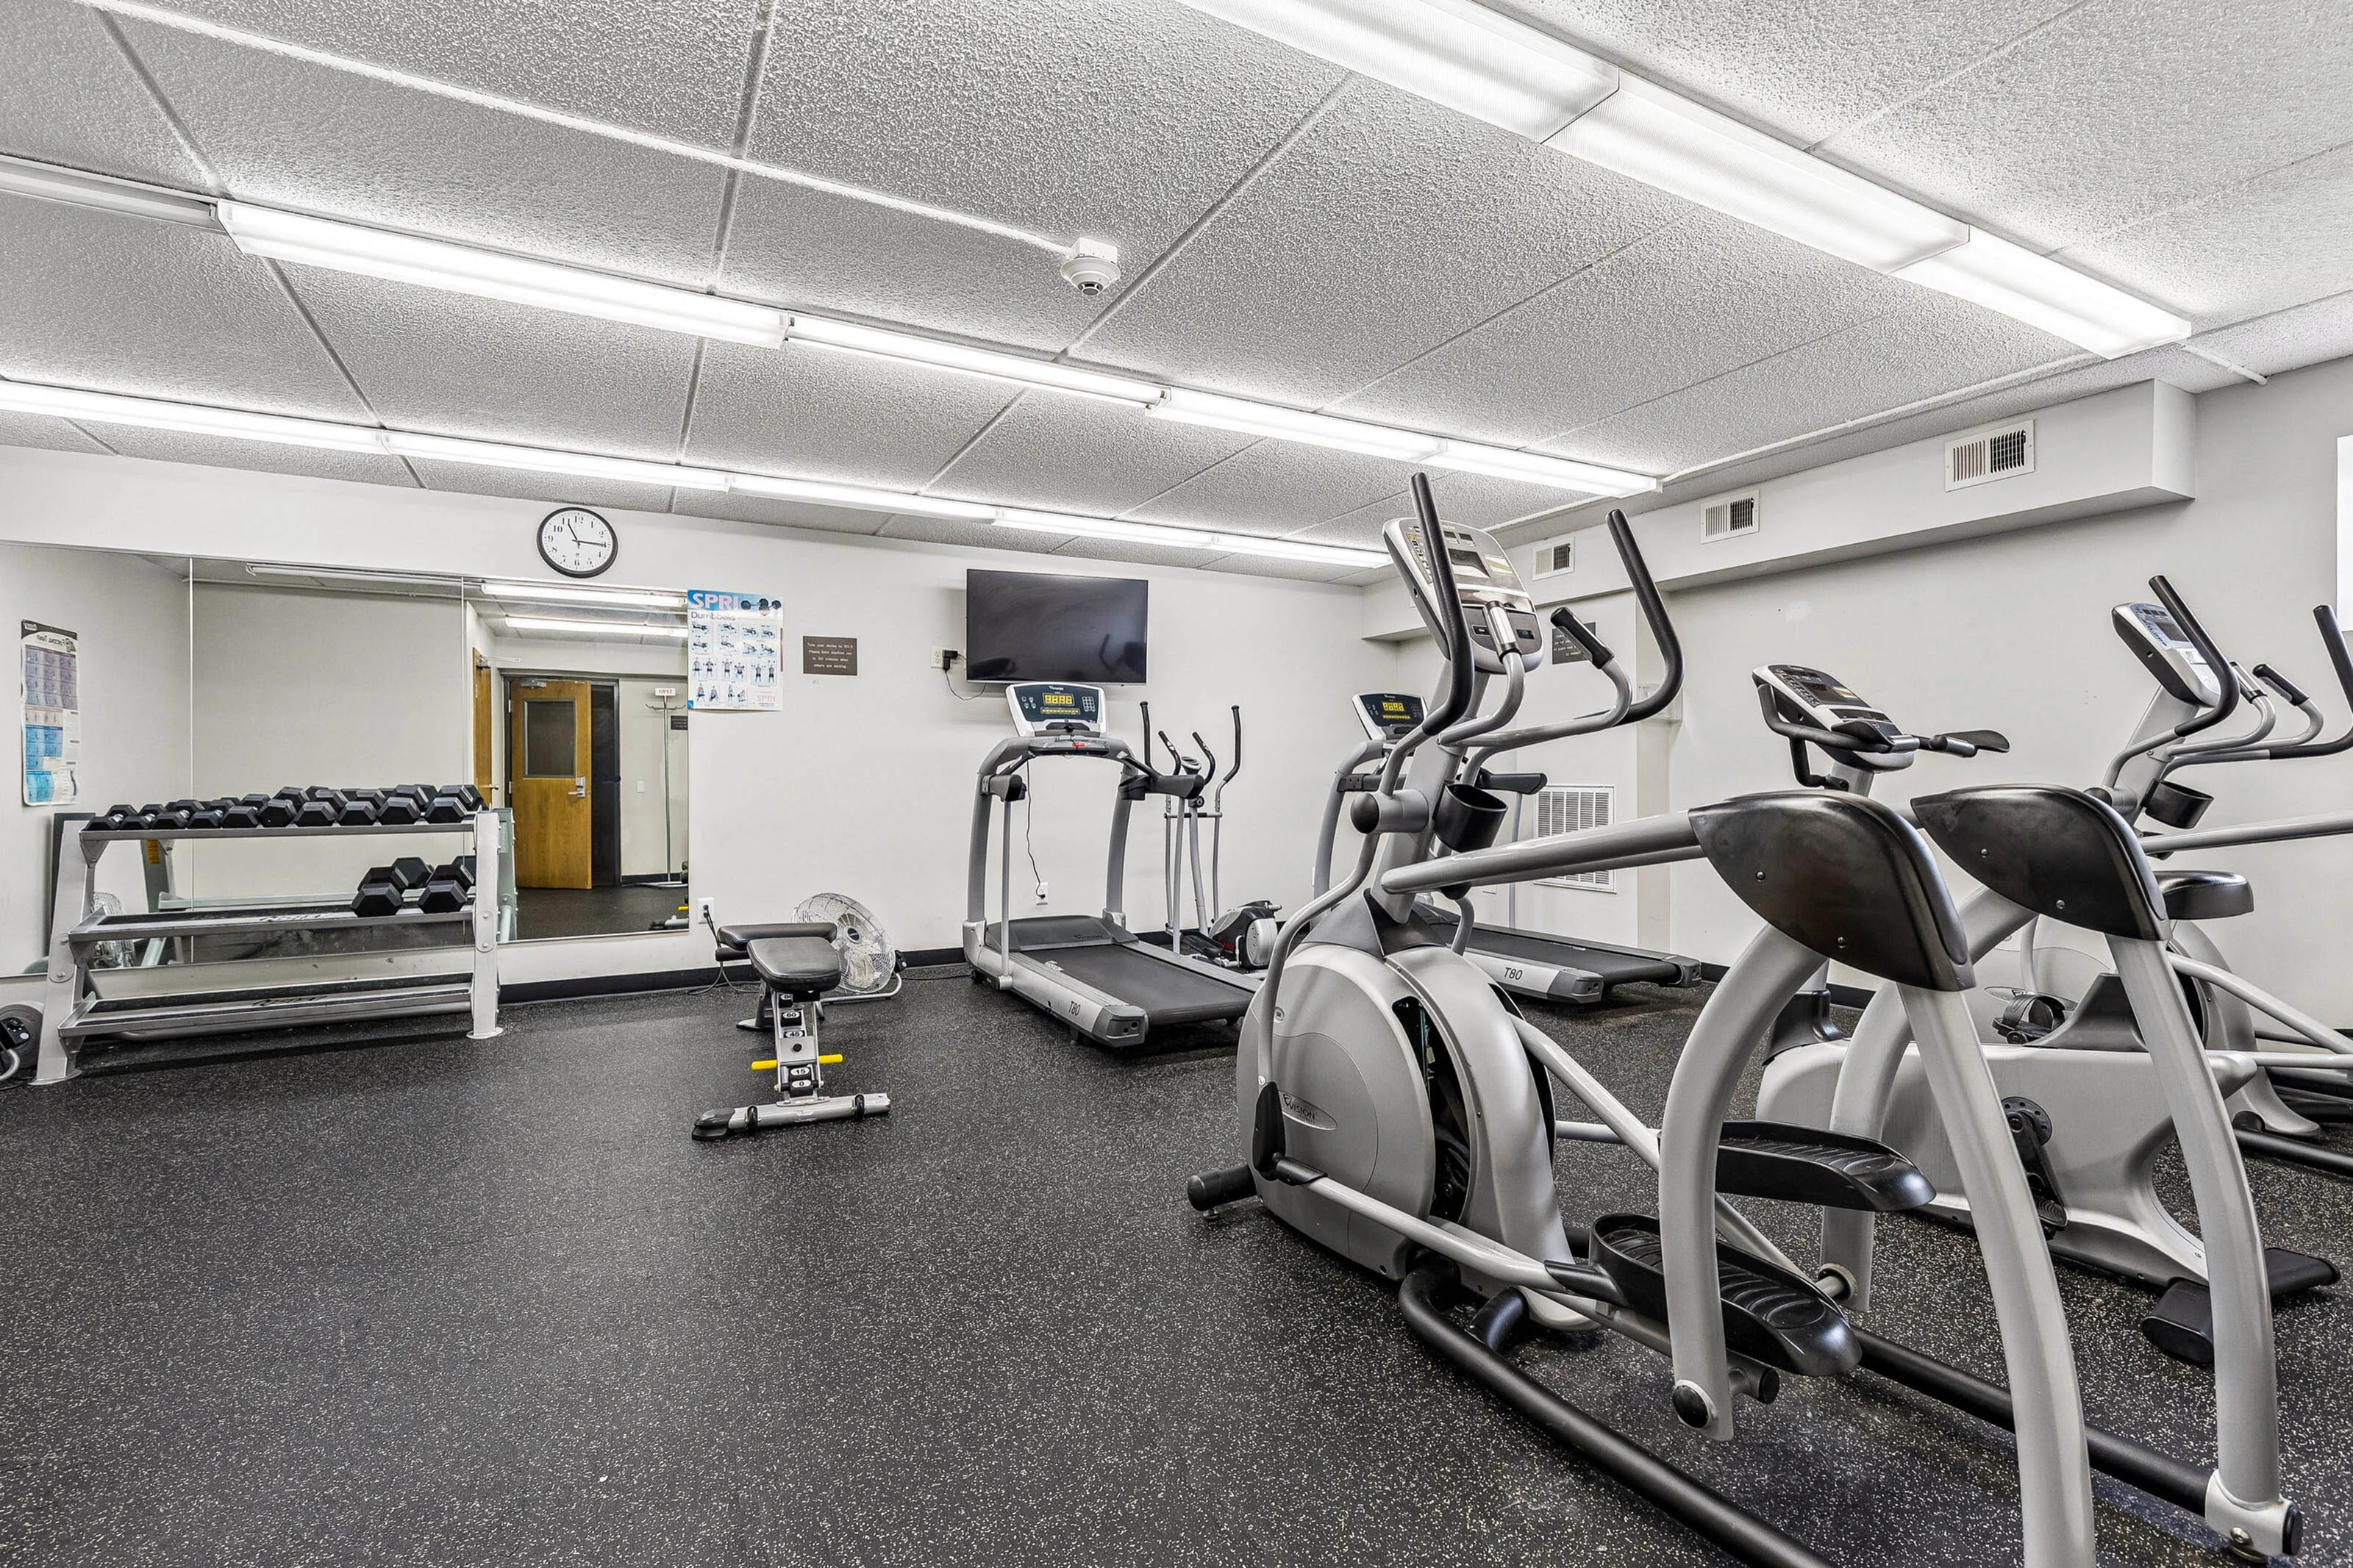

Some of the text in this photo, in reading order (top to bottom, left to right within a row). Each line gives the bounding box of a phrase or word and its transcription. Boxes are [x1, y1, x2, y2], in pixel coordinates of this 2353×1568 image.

[574, 515, 584, 524] 12
[553, 525, 563, 533] 10
[548, 534, 554, 543] 9
[562, 554, 567, 562] 7
[586, 557, 593, 565] 5
[693, 593, 739, 611] SPRI
[691, 611, 736, 620] Dumbbells
[1504, 967, 1523, 981] T80
[1068, 1000, 1081, 1016] T80
[1289, 1103, 1315, 1120] VISION
